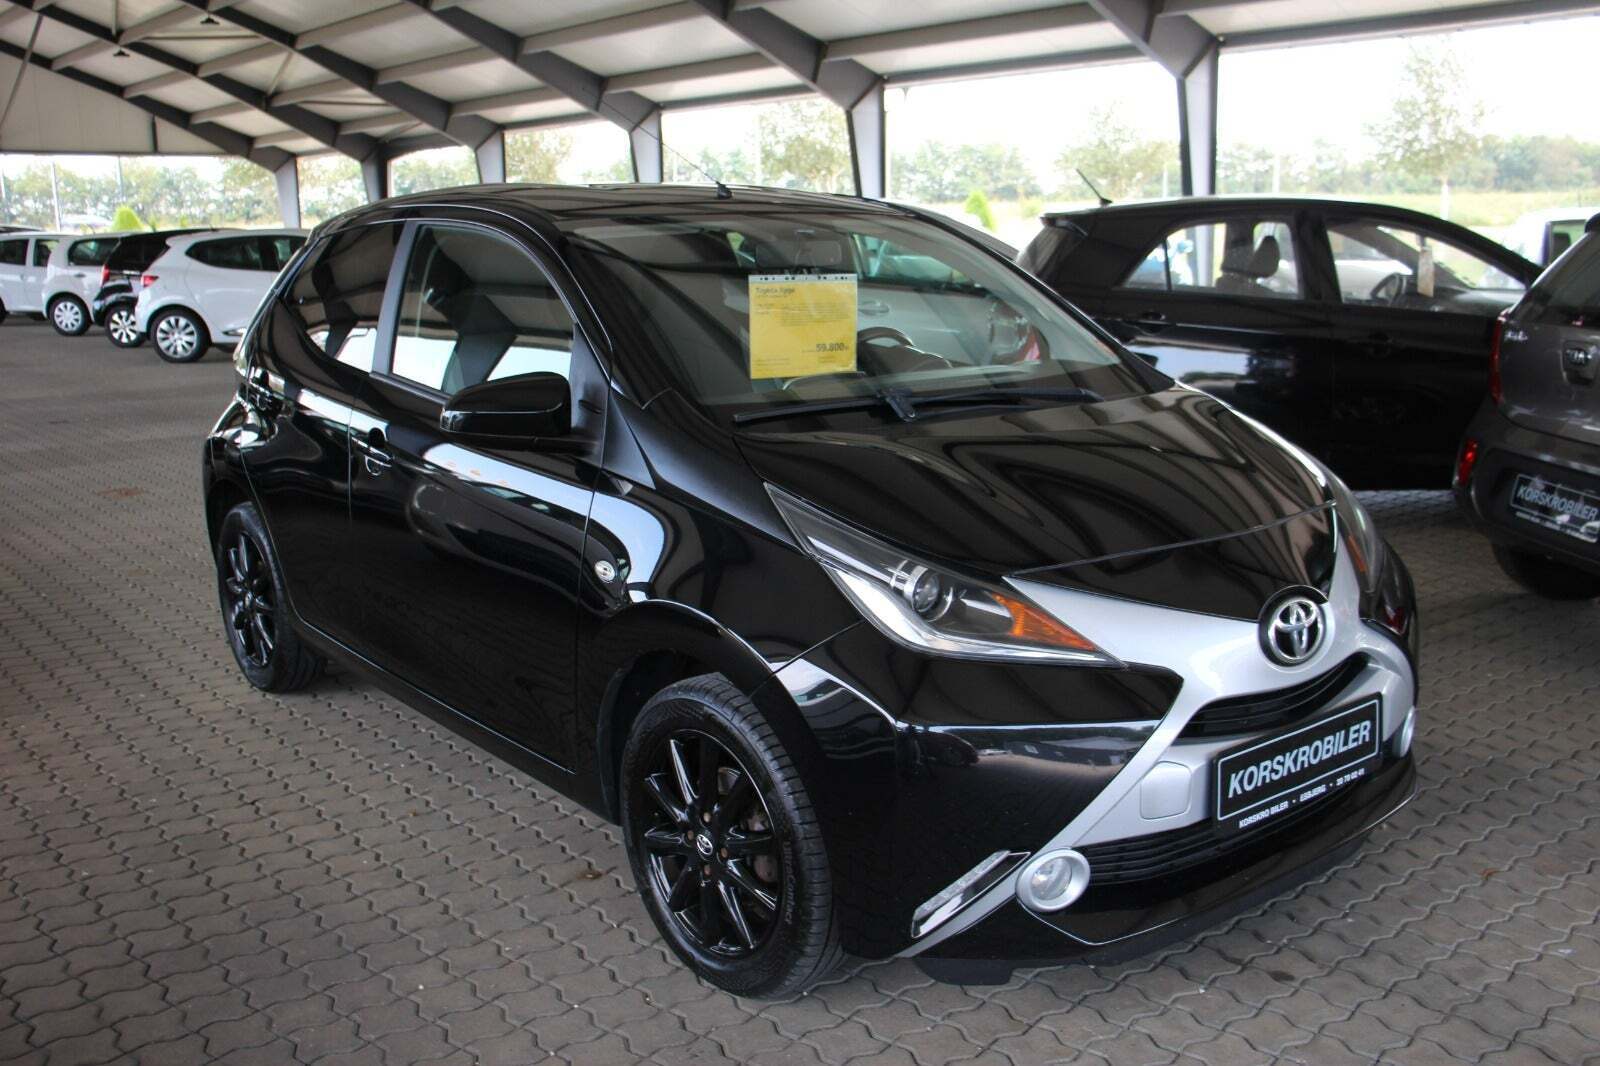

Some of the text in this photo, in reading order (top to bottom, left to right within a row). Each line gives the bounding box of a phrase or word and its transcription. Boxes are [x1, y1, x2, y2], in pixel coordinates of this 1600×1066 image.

[1516, 484, 1598, 521] KORSKROBILER
[1228, 720, 1371, 799] KORSKROBILER
[1239, 808, 1270, 829] KORSKRO
[1270, 800, 1289, 815] BILER
